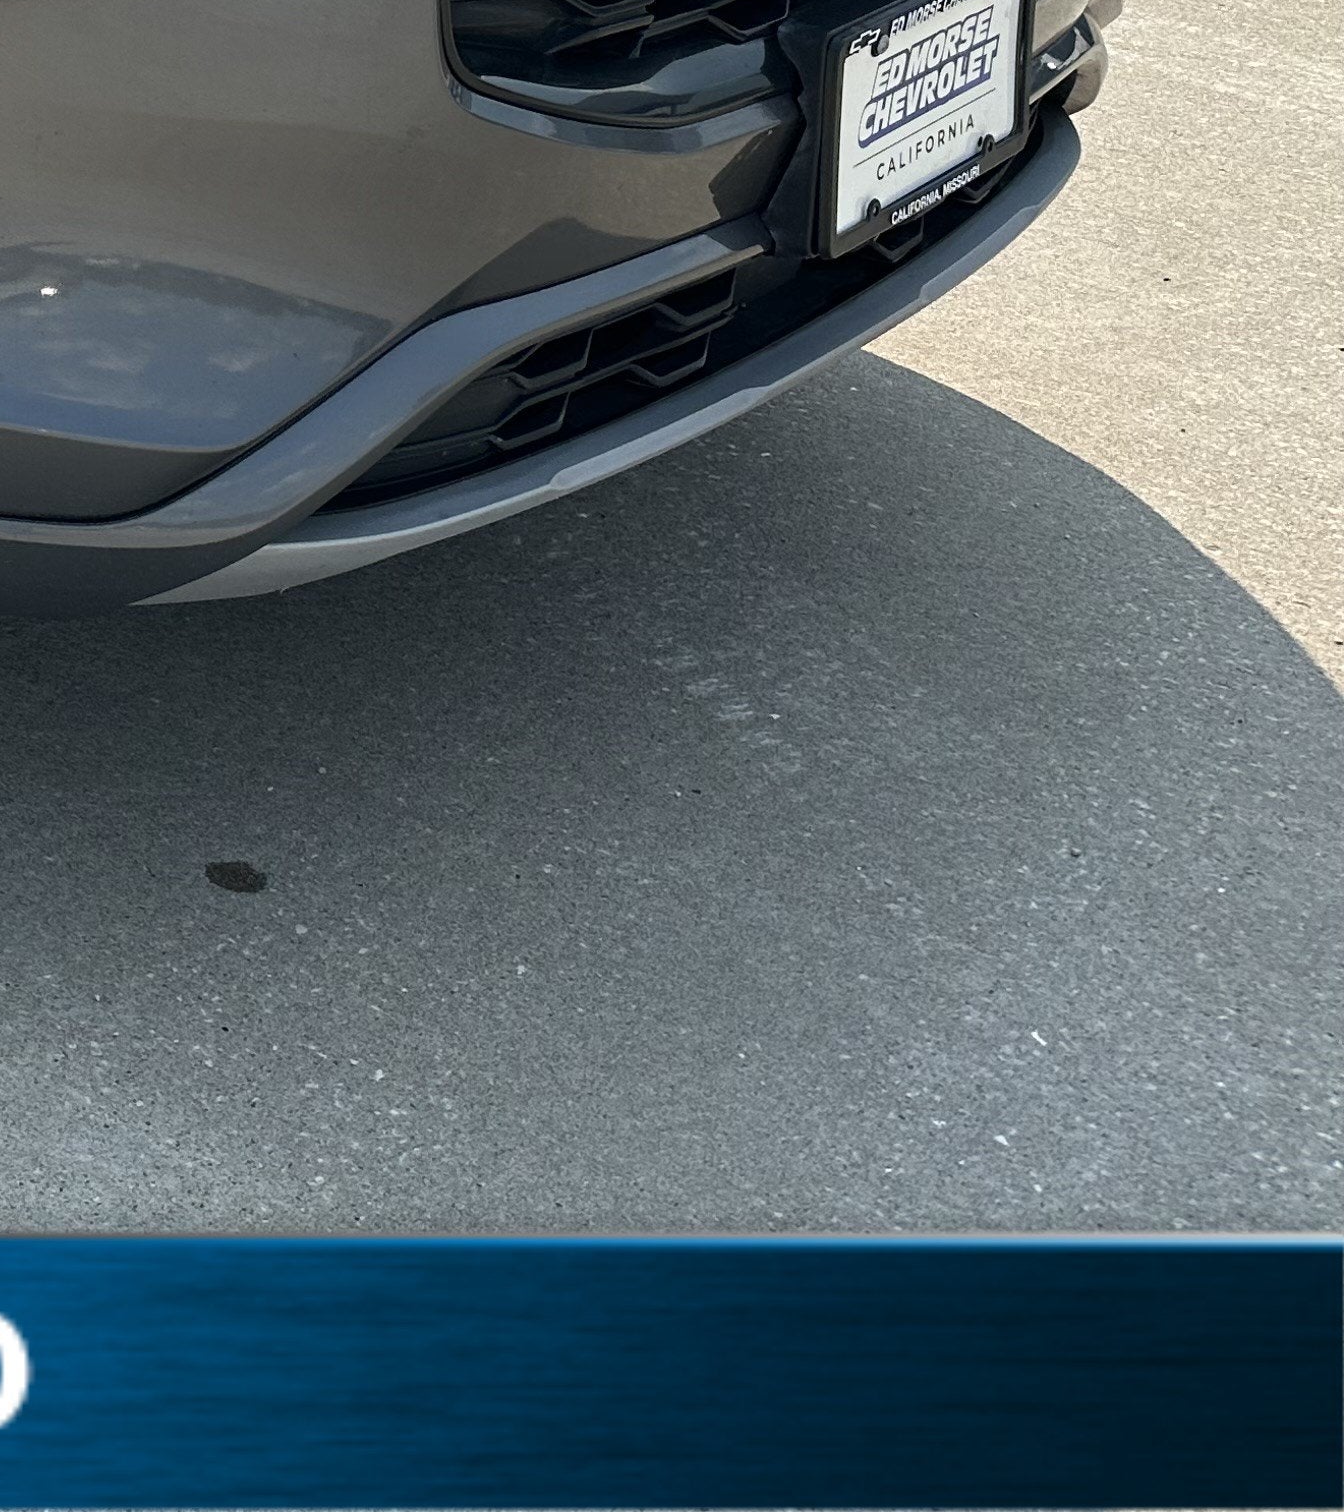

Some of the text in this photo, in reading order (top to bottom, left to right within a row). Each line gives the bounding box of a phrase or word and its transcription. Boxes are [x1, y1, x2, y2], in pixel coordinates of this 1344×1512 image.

[874, 8, 994, 93] ED MORSE
[890, 15, 909, 37] ED
[861, 43, 1000, 143] CHEVROLET
[876, 114, 976, 180] CALIFORNIA
[891, 163, 981, 225] CALIFORNIA, MISSOURI
